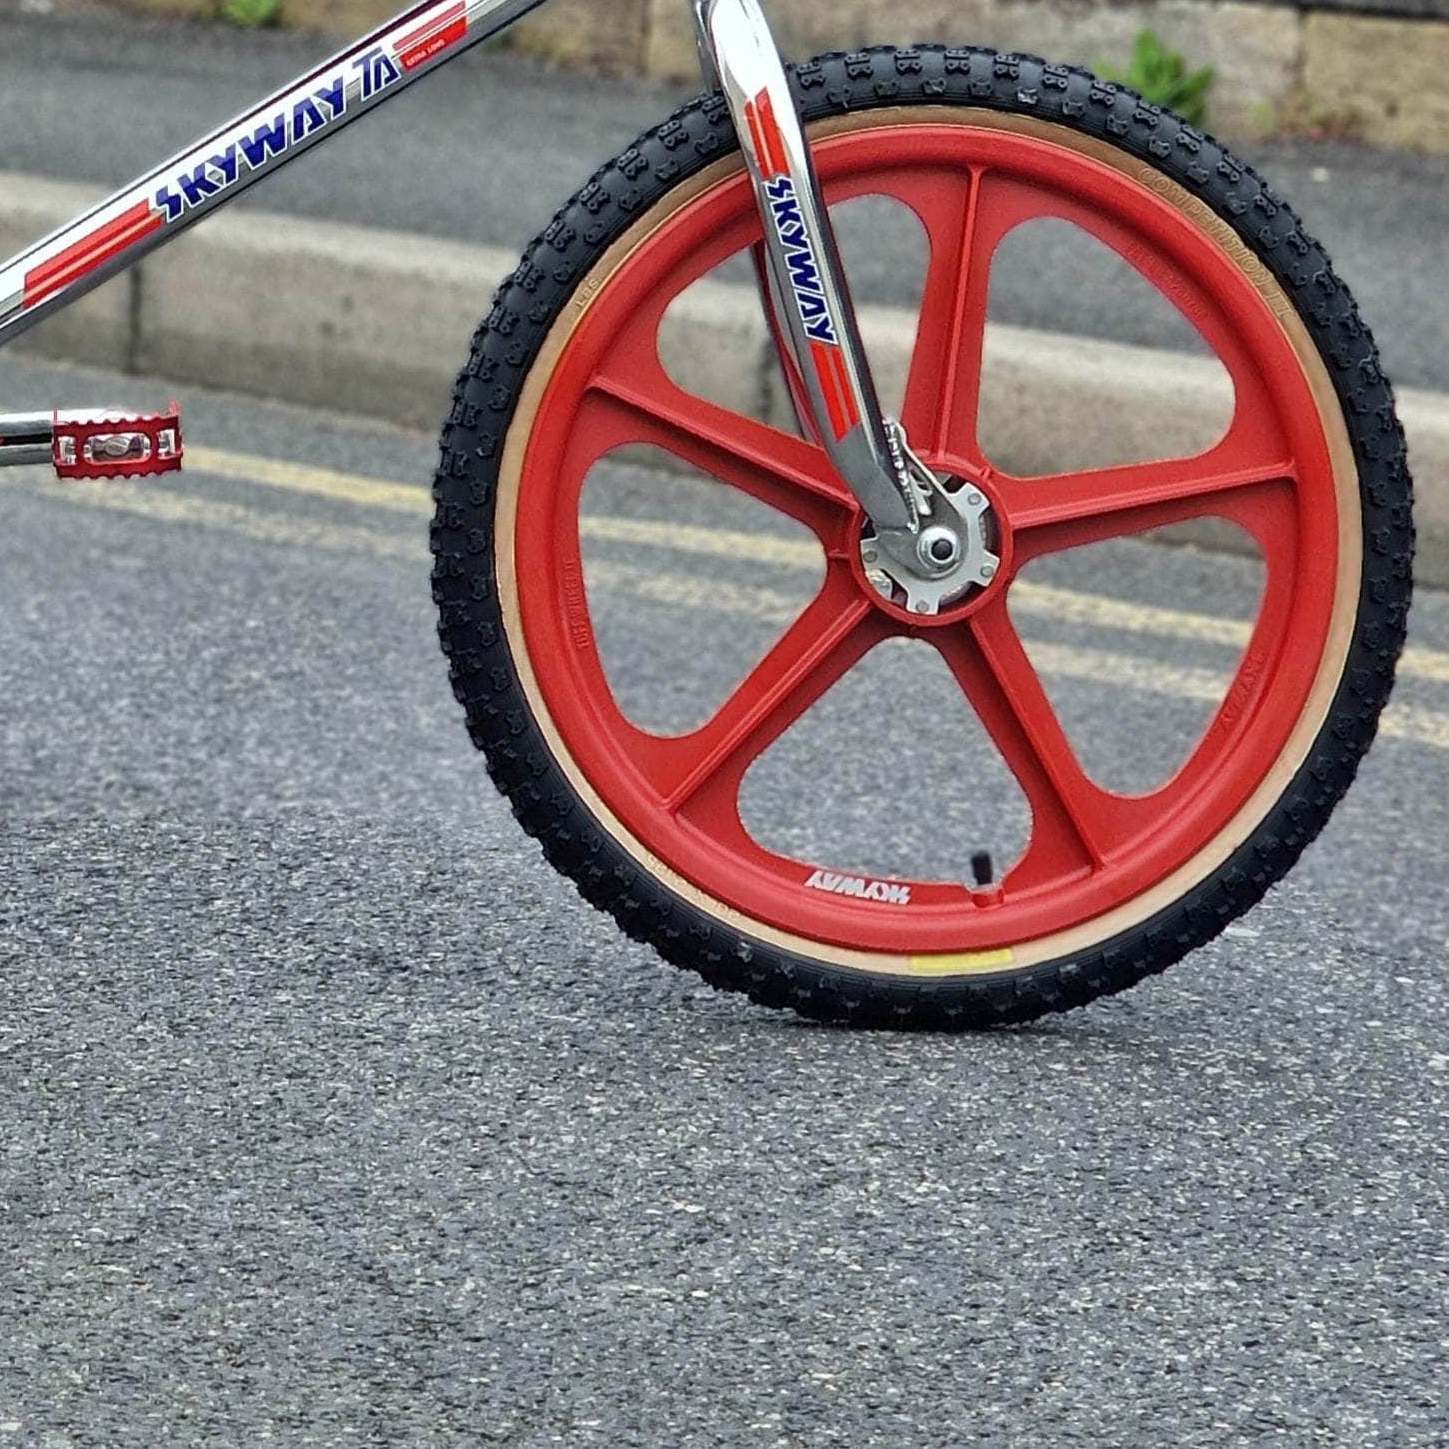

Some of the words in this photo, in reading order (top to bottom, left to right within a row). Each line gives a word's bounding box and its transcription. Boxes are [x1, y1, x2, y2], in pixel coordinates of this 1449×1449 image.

[155, 75, 346, 223] SKYWAY
[765, 175, 839, 345] SKYWAY
[804, 869, 912, 905] SKYWAY
